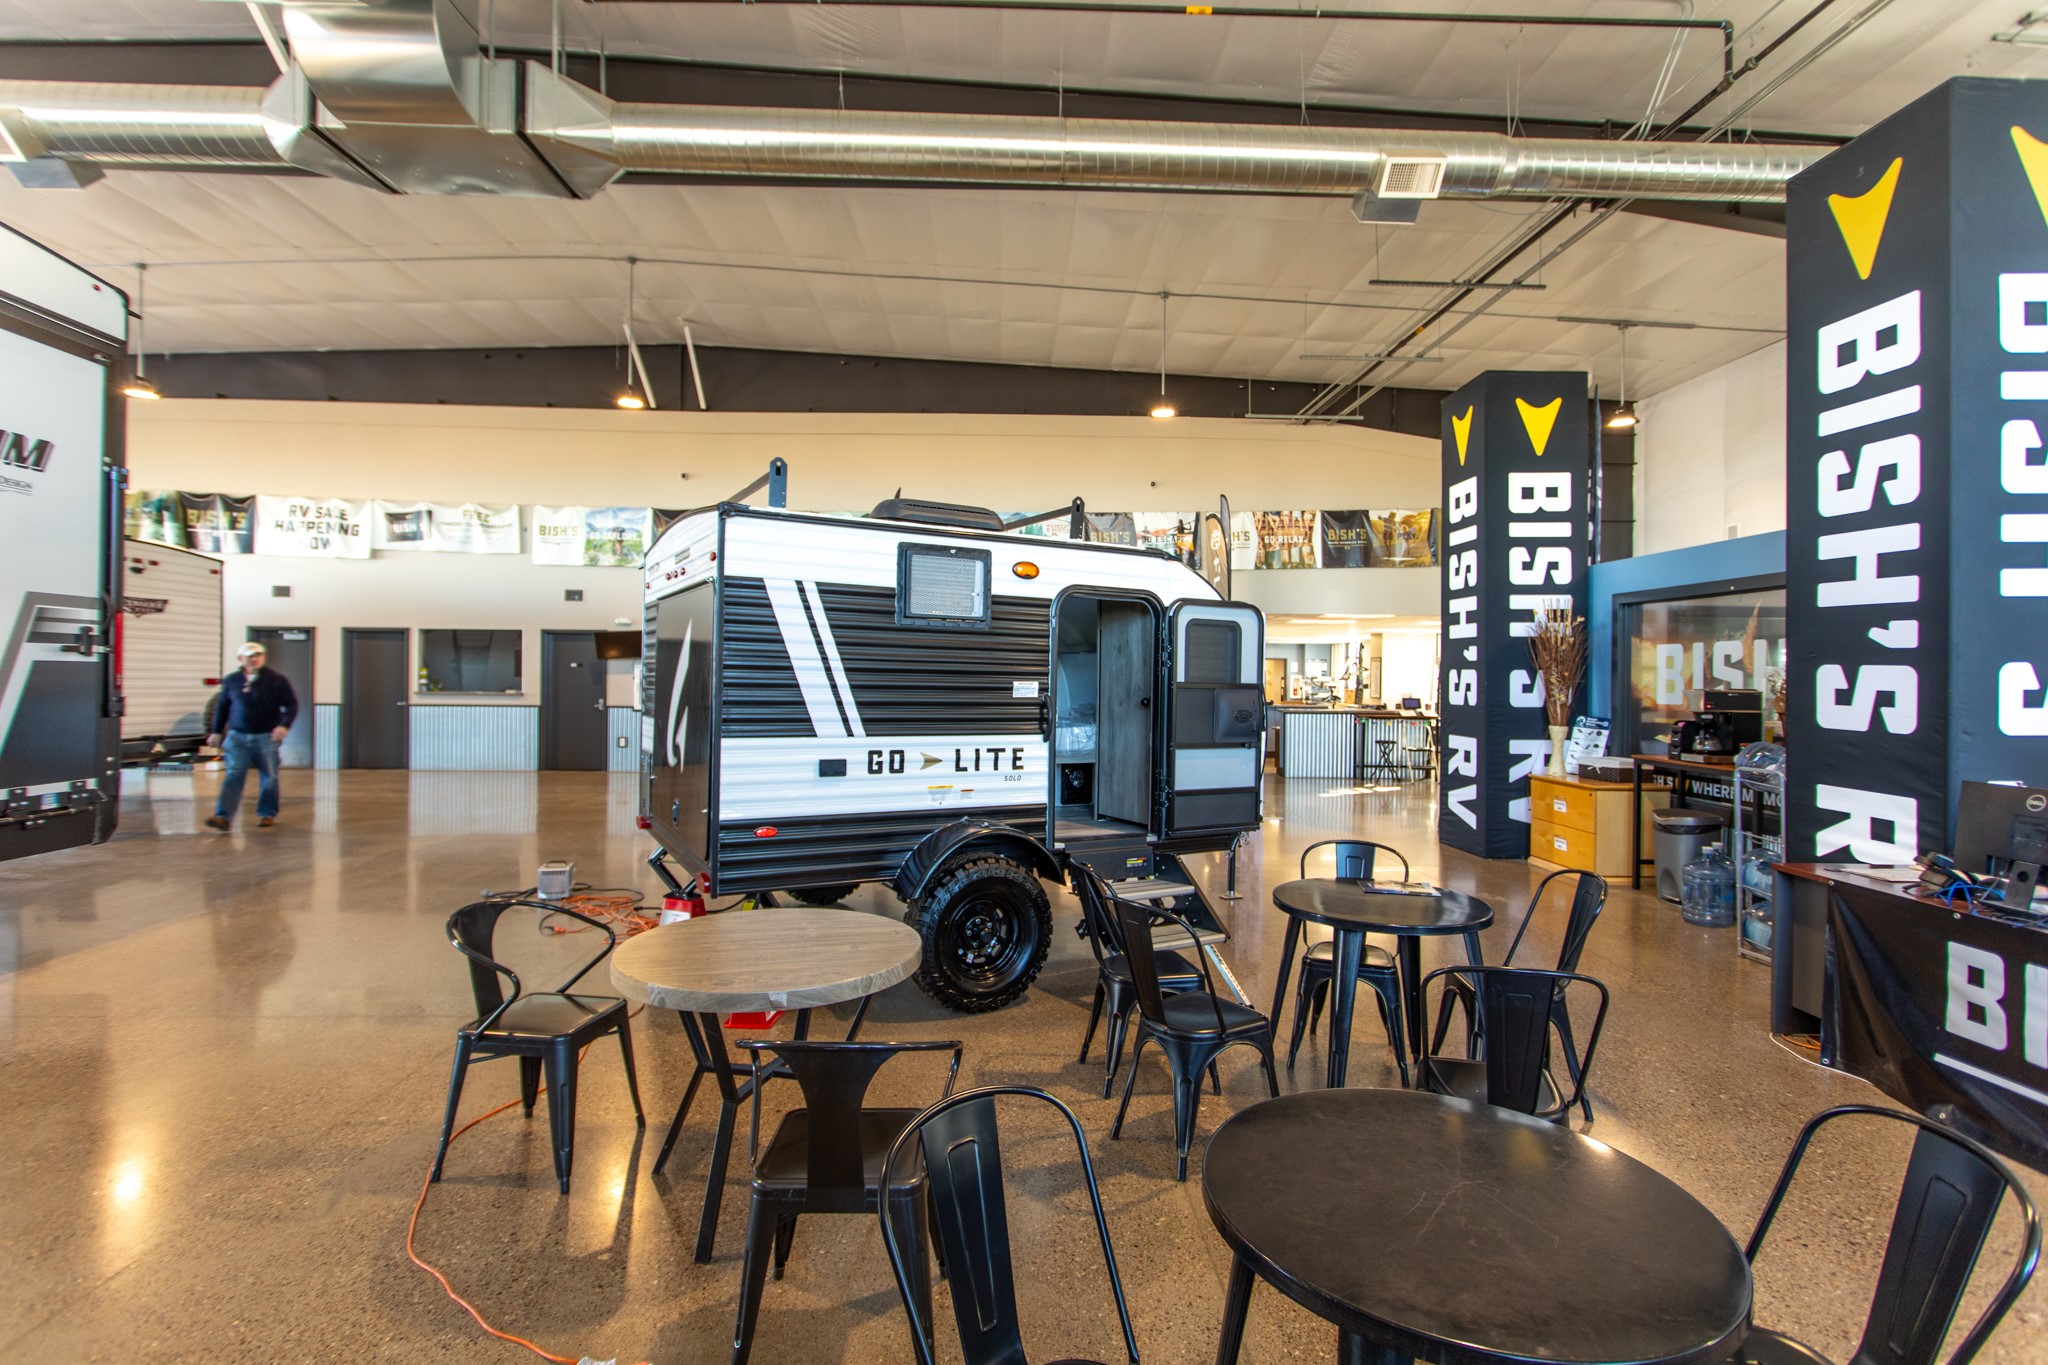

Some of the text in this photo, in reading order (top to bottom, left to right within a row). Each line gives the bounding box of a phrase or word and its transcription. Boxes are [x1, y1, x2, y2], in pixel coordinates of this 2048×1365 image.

[289, 505, 310, 518] RV
[1817, 289, 1922, 736] BISH'S
[275, 519, 360, 537] HAPENNG
[538, 525, 579, 537] BISH'S
[1327, 528, 1367, 541] BISH'S
[299, 536, 331, 550] OW
[1090, 531, 1131, 543] BISH'S
[1264, 535, 1307, 544] GO RELAX.
[1508, 472, 1573, 709] BISHS
[1447, 475, 1478, 831] BISH'S RV
[867, 747, 1025, 775] GO LITE
[1003, 774, 1022, 782] SOLO
